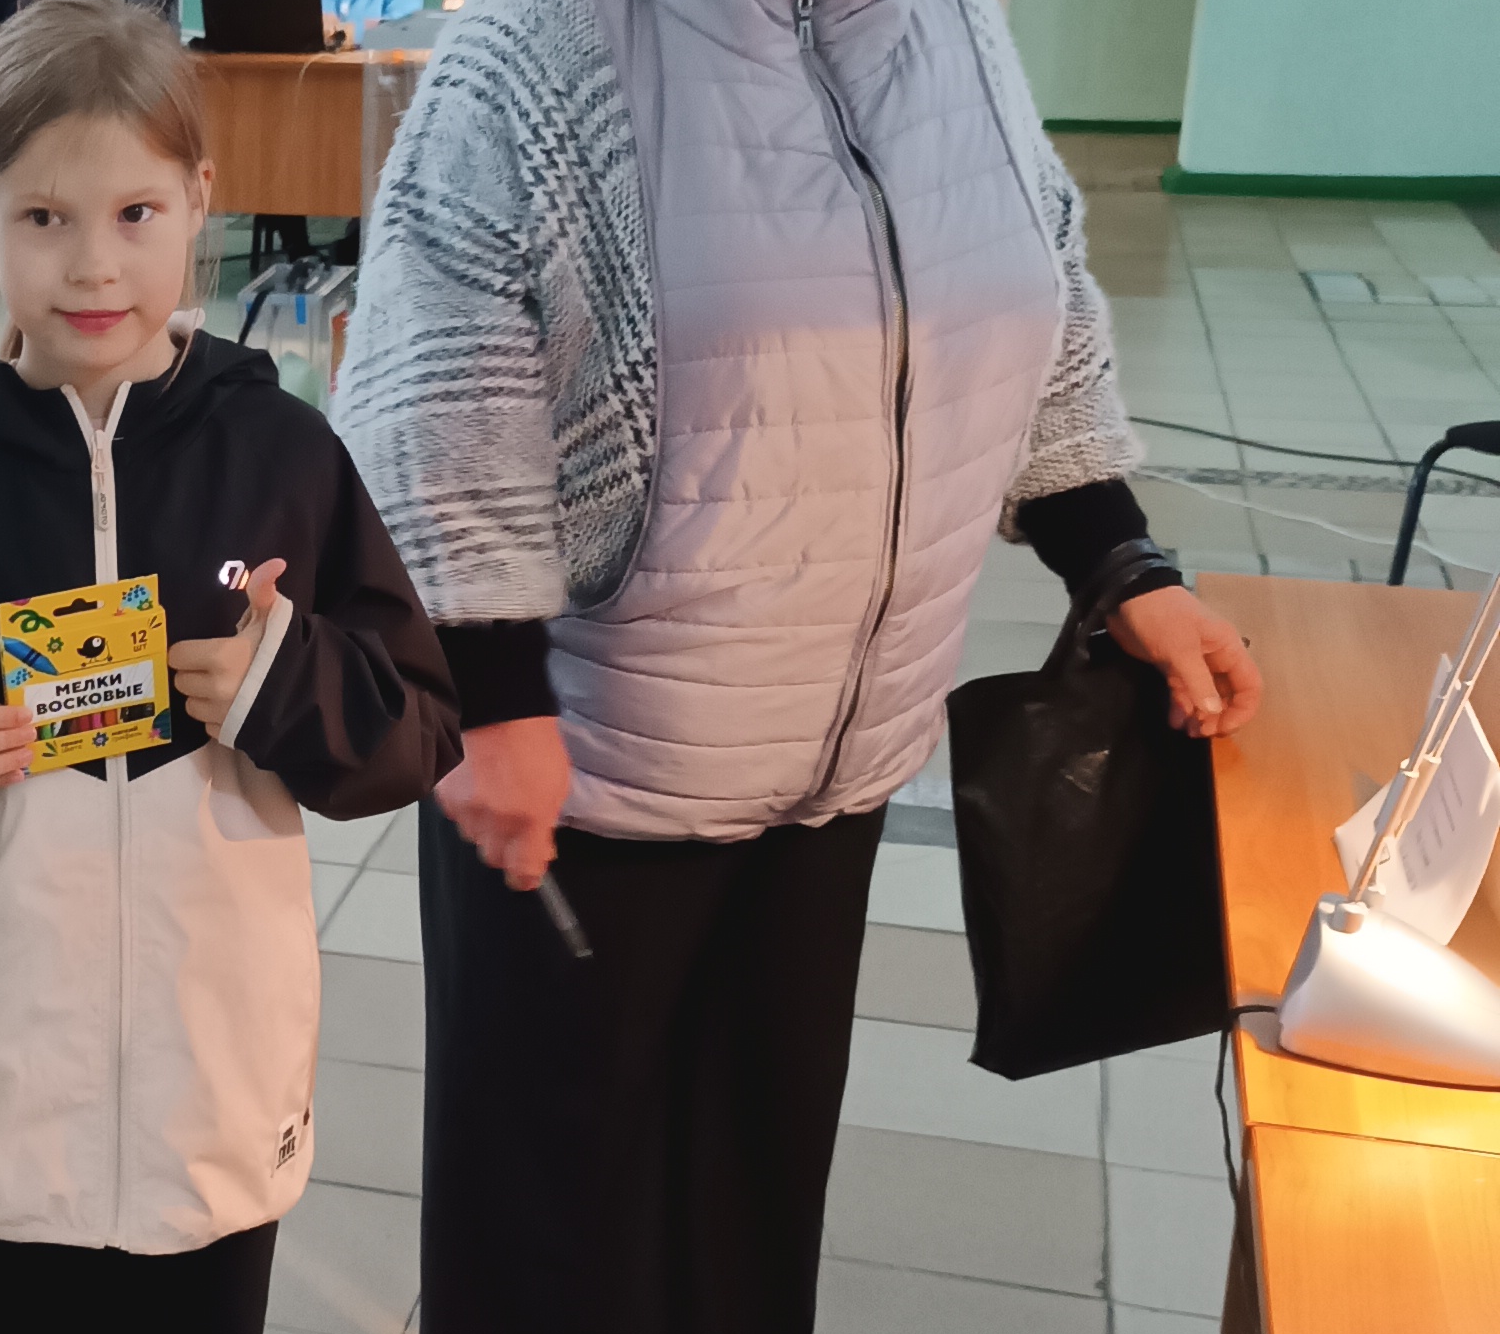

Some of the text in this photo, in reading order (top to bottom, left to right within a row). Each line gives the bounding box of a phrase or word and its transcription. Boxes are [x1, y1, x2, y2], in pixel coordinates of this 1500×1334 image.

[130, 630, 148, 644] 12
[55, 673, 122, 697] МЕЛКИ
[36, 683, 143, 715] ВОСКОВЫЕ
